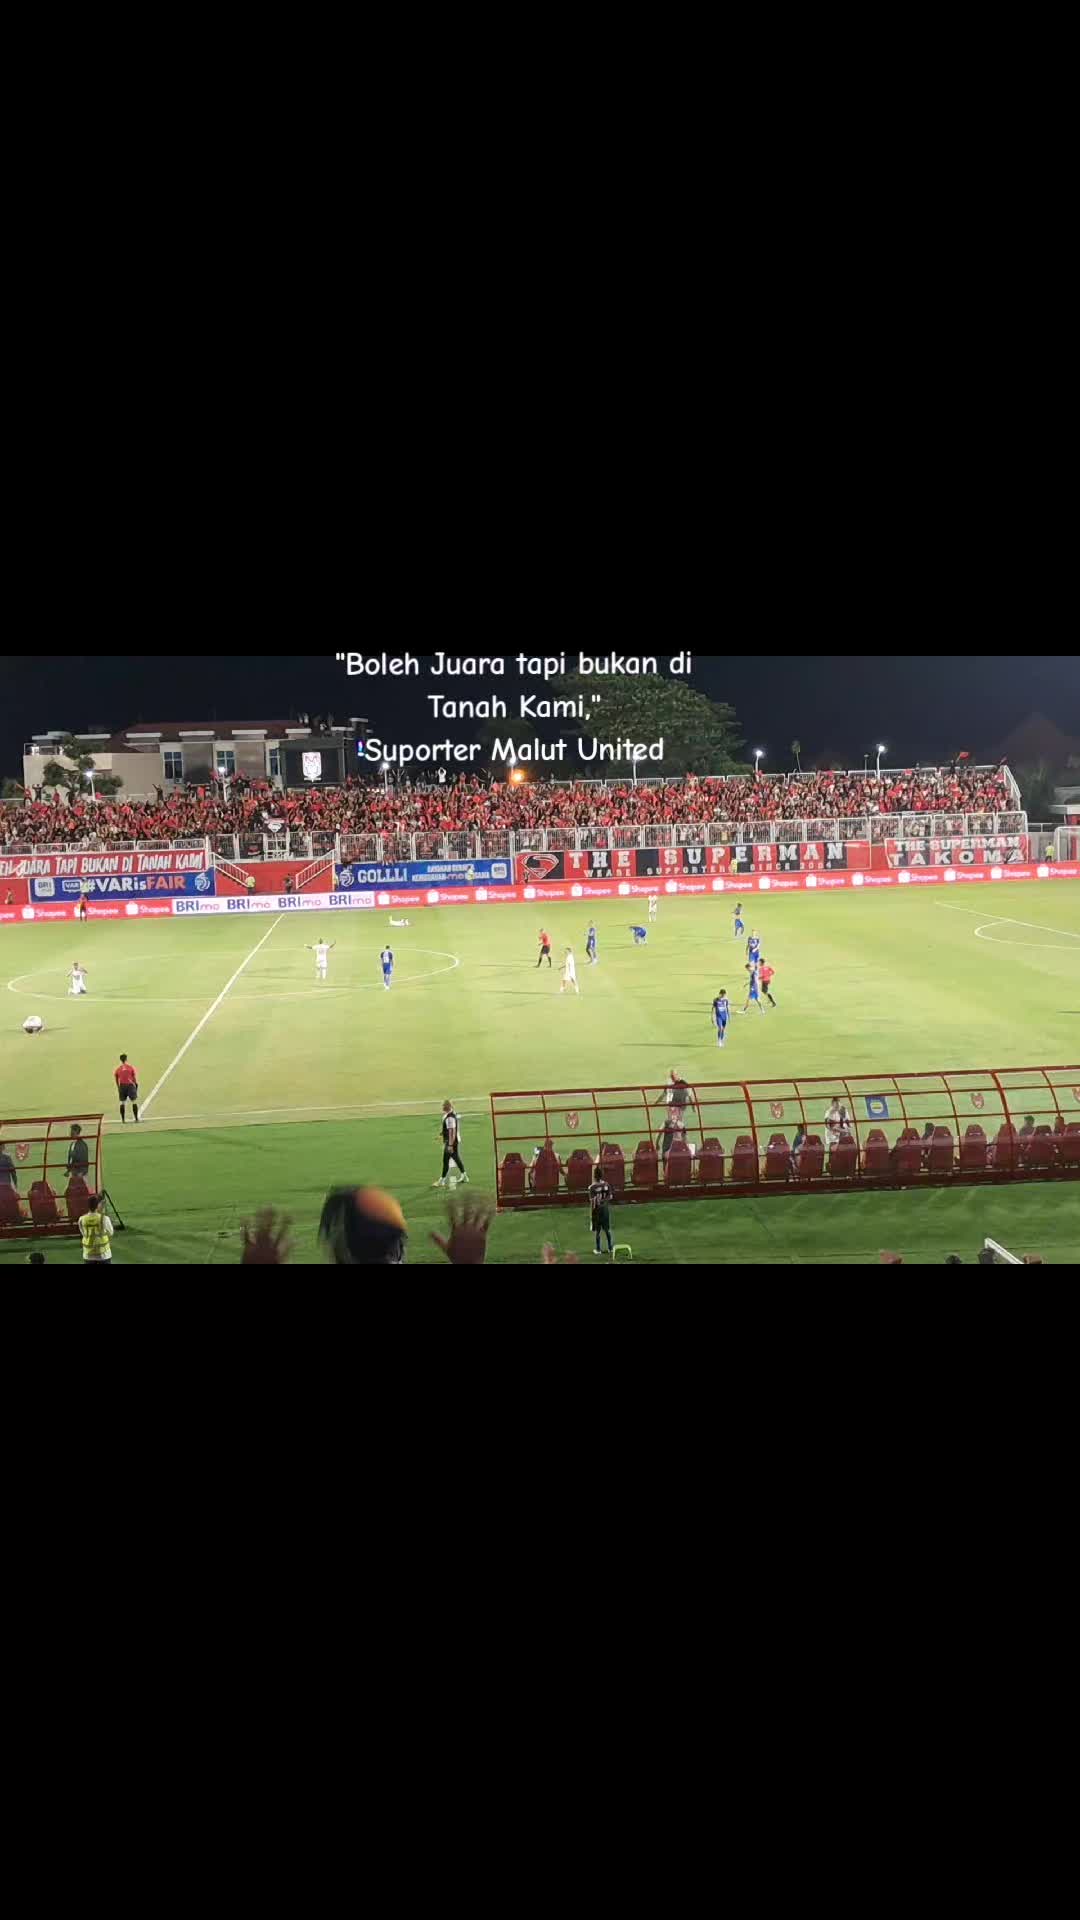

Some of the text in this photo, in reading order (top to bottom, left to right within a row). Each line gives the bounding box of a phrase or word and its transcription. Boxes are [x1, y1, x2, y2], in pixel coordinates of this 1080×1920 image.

[895, 836, 1021, 851] THE SUPERMAN
[569, 842, 844, 868] THE SUPERMAN
[888, 849, 1024, 866] TAKOMA
[55, 857, 78, 875] TAPI
[81, 856, 120, 873] BUKAN
[122, 854, 134, 872] DI
[137, 853, 172, 871] TANAH
[175, 852, 204, 870] KAMI
[176, 900, 220, 912] BRImo
[227, 898, 271, 910] BRImo
[278, 896, 322, 908] BRImo
[329, 894, 372, 906] BRImo
